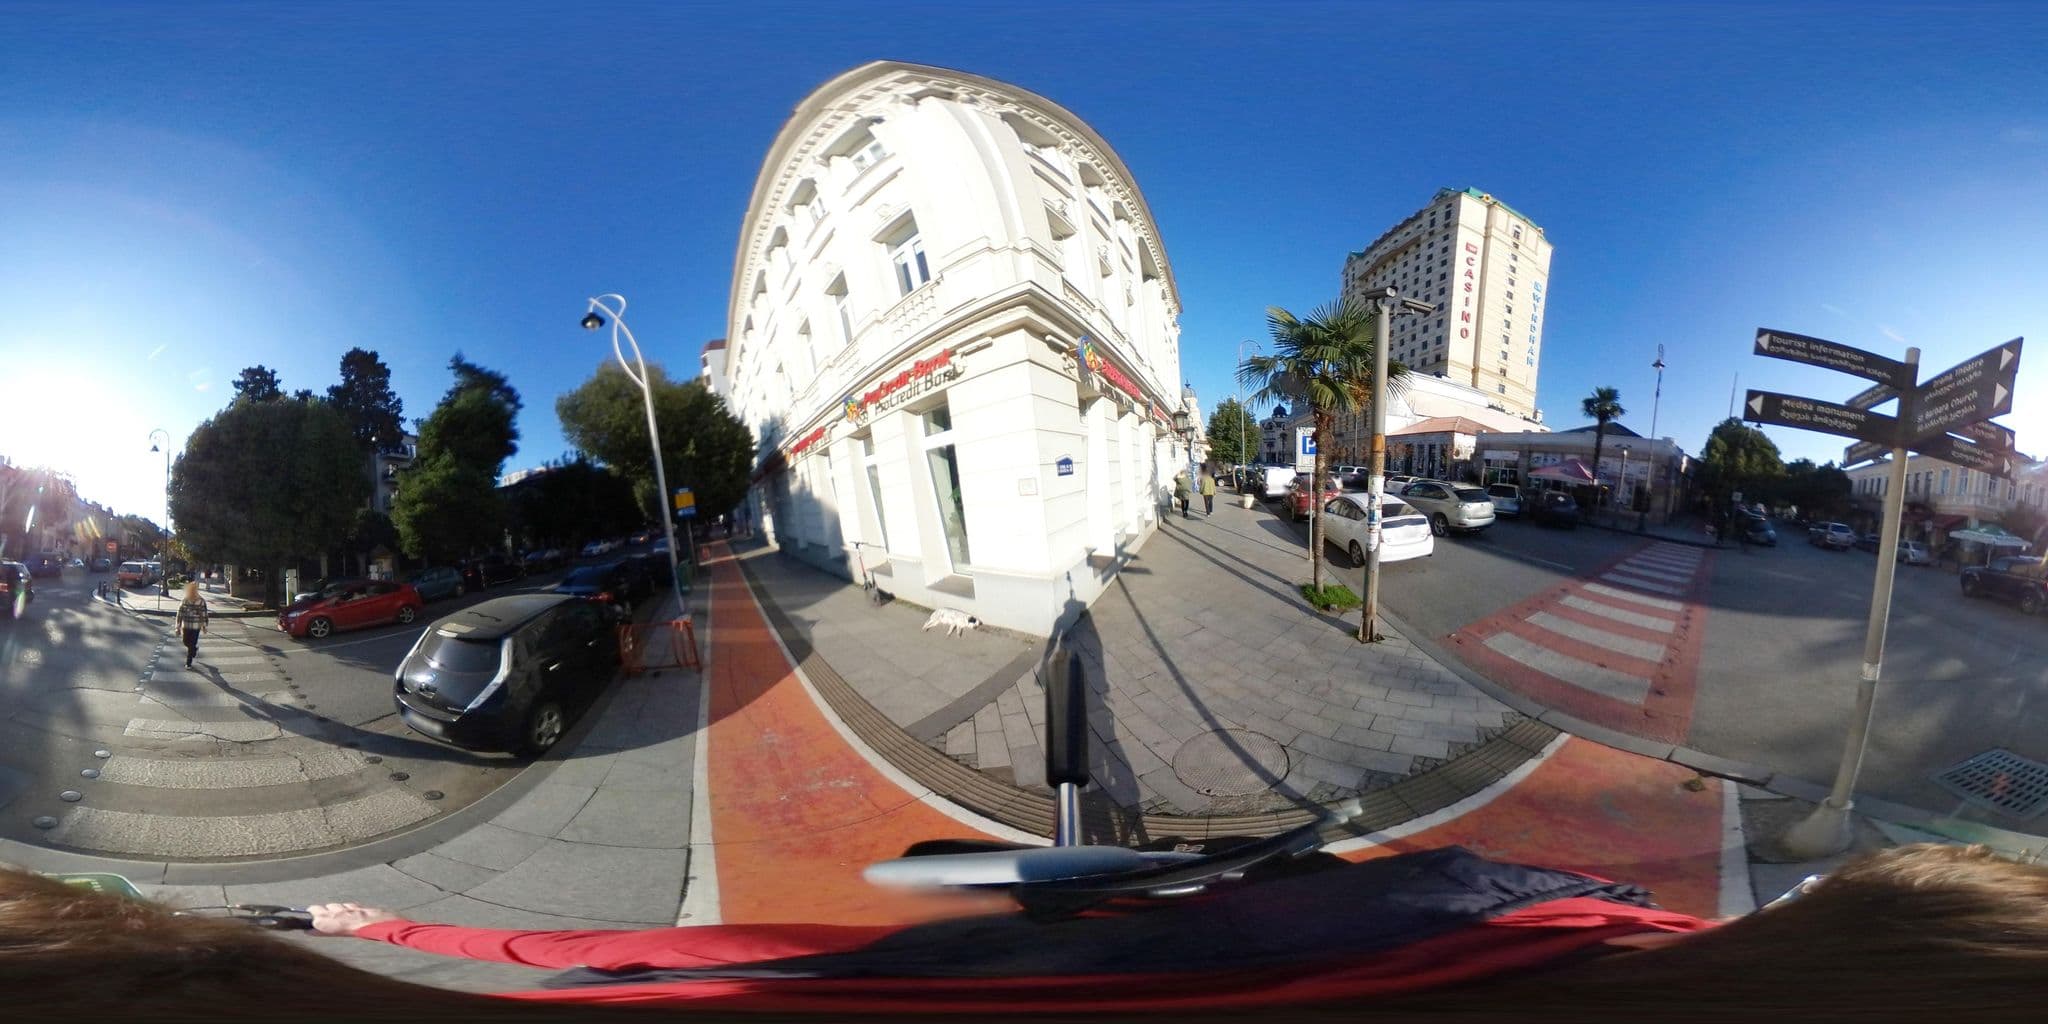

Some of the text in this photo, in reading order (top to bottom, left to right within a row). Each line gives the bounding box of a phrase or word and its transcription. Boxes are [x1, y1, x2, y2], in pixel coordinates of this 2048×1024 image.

[1460, 256, 1475, 339] CASINO
[1527, 293, 1541, 368] WYNDHAM
[1772, 335, 1807, 349] Tourist
[1810, 343, 1864, 362] information
[914, 348, 951, 379] Bank
[1782, 400, 1866, 422] Medea monument
[1950, 390, 1978, 408] Church
